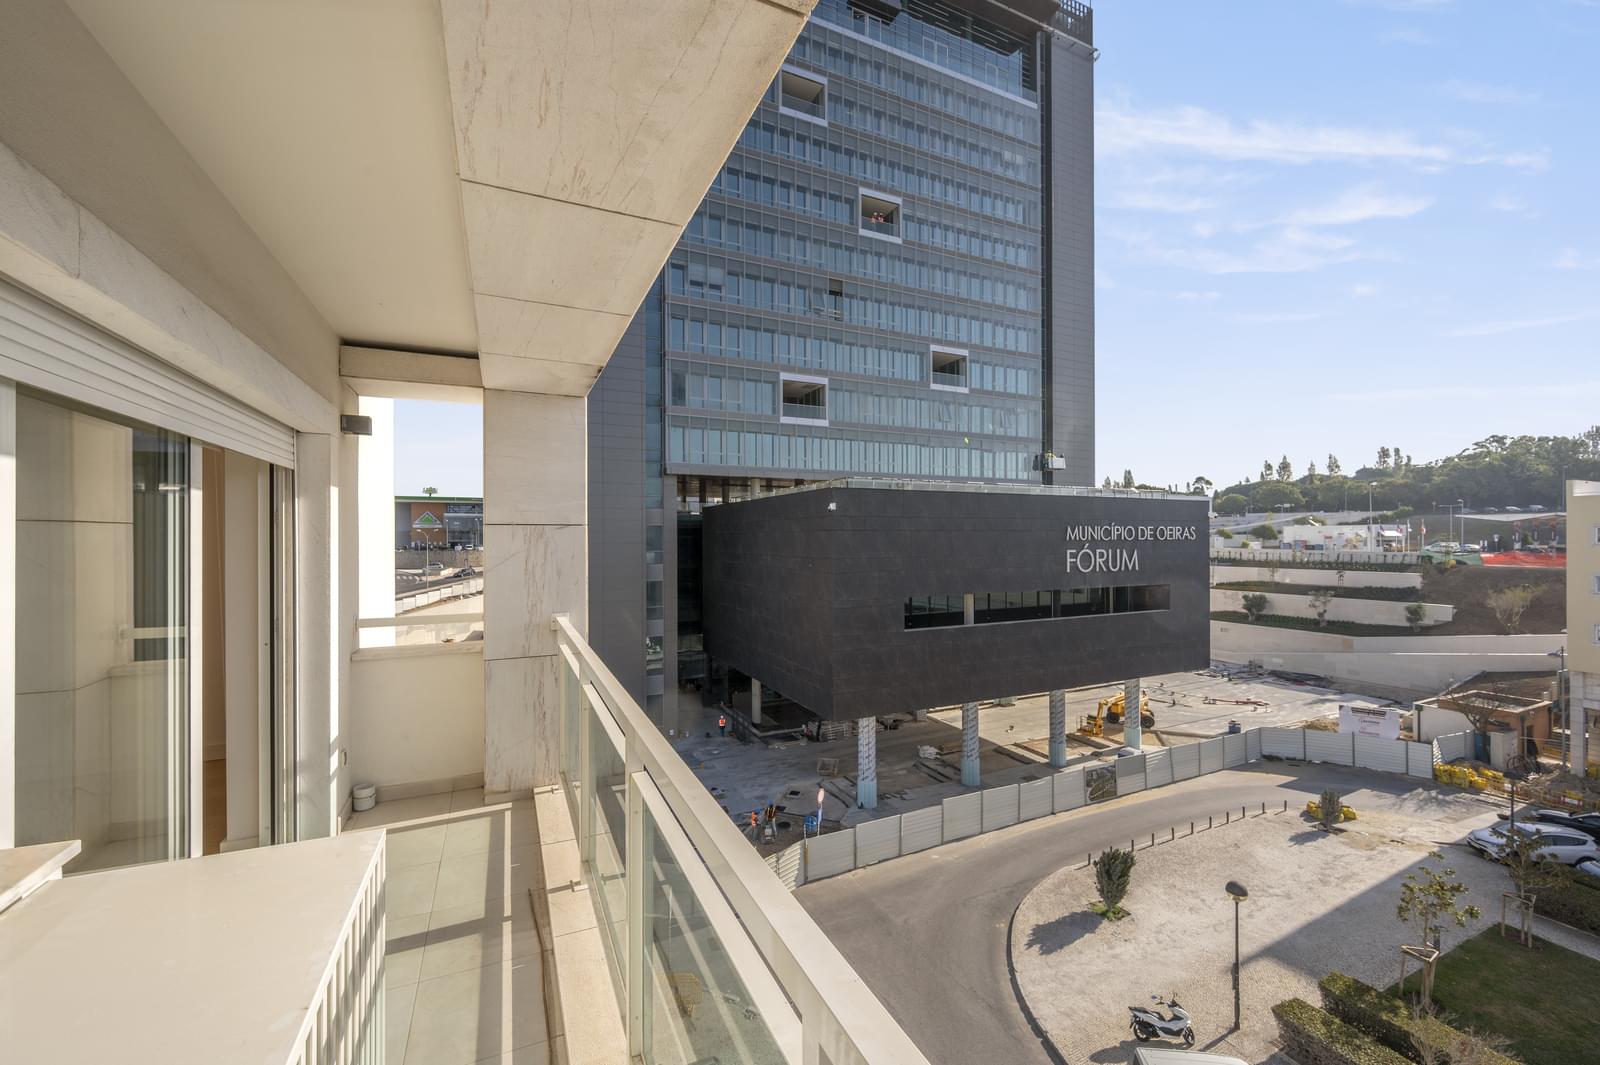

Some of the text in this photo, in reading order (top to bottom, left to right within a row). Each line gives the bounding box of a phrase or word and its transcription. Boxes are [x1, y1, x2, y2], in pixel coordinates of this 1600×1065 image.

[1066, 522, 1196, 541] MUNICÍPIO DE OEIRAS
[1066, 543, 1139, 573] FÓRUM
